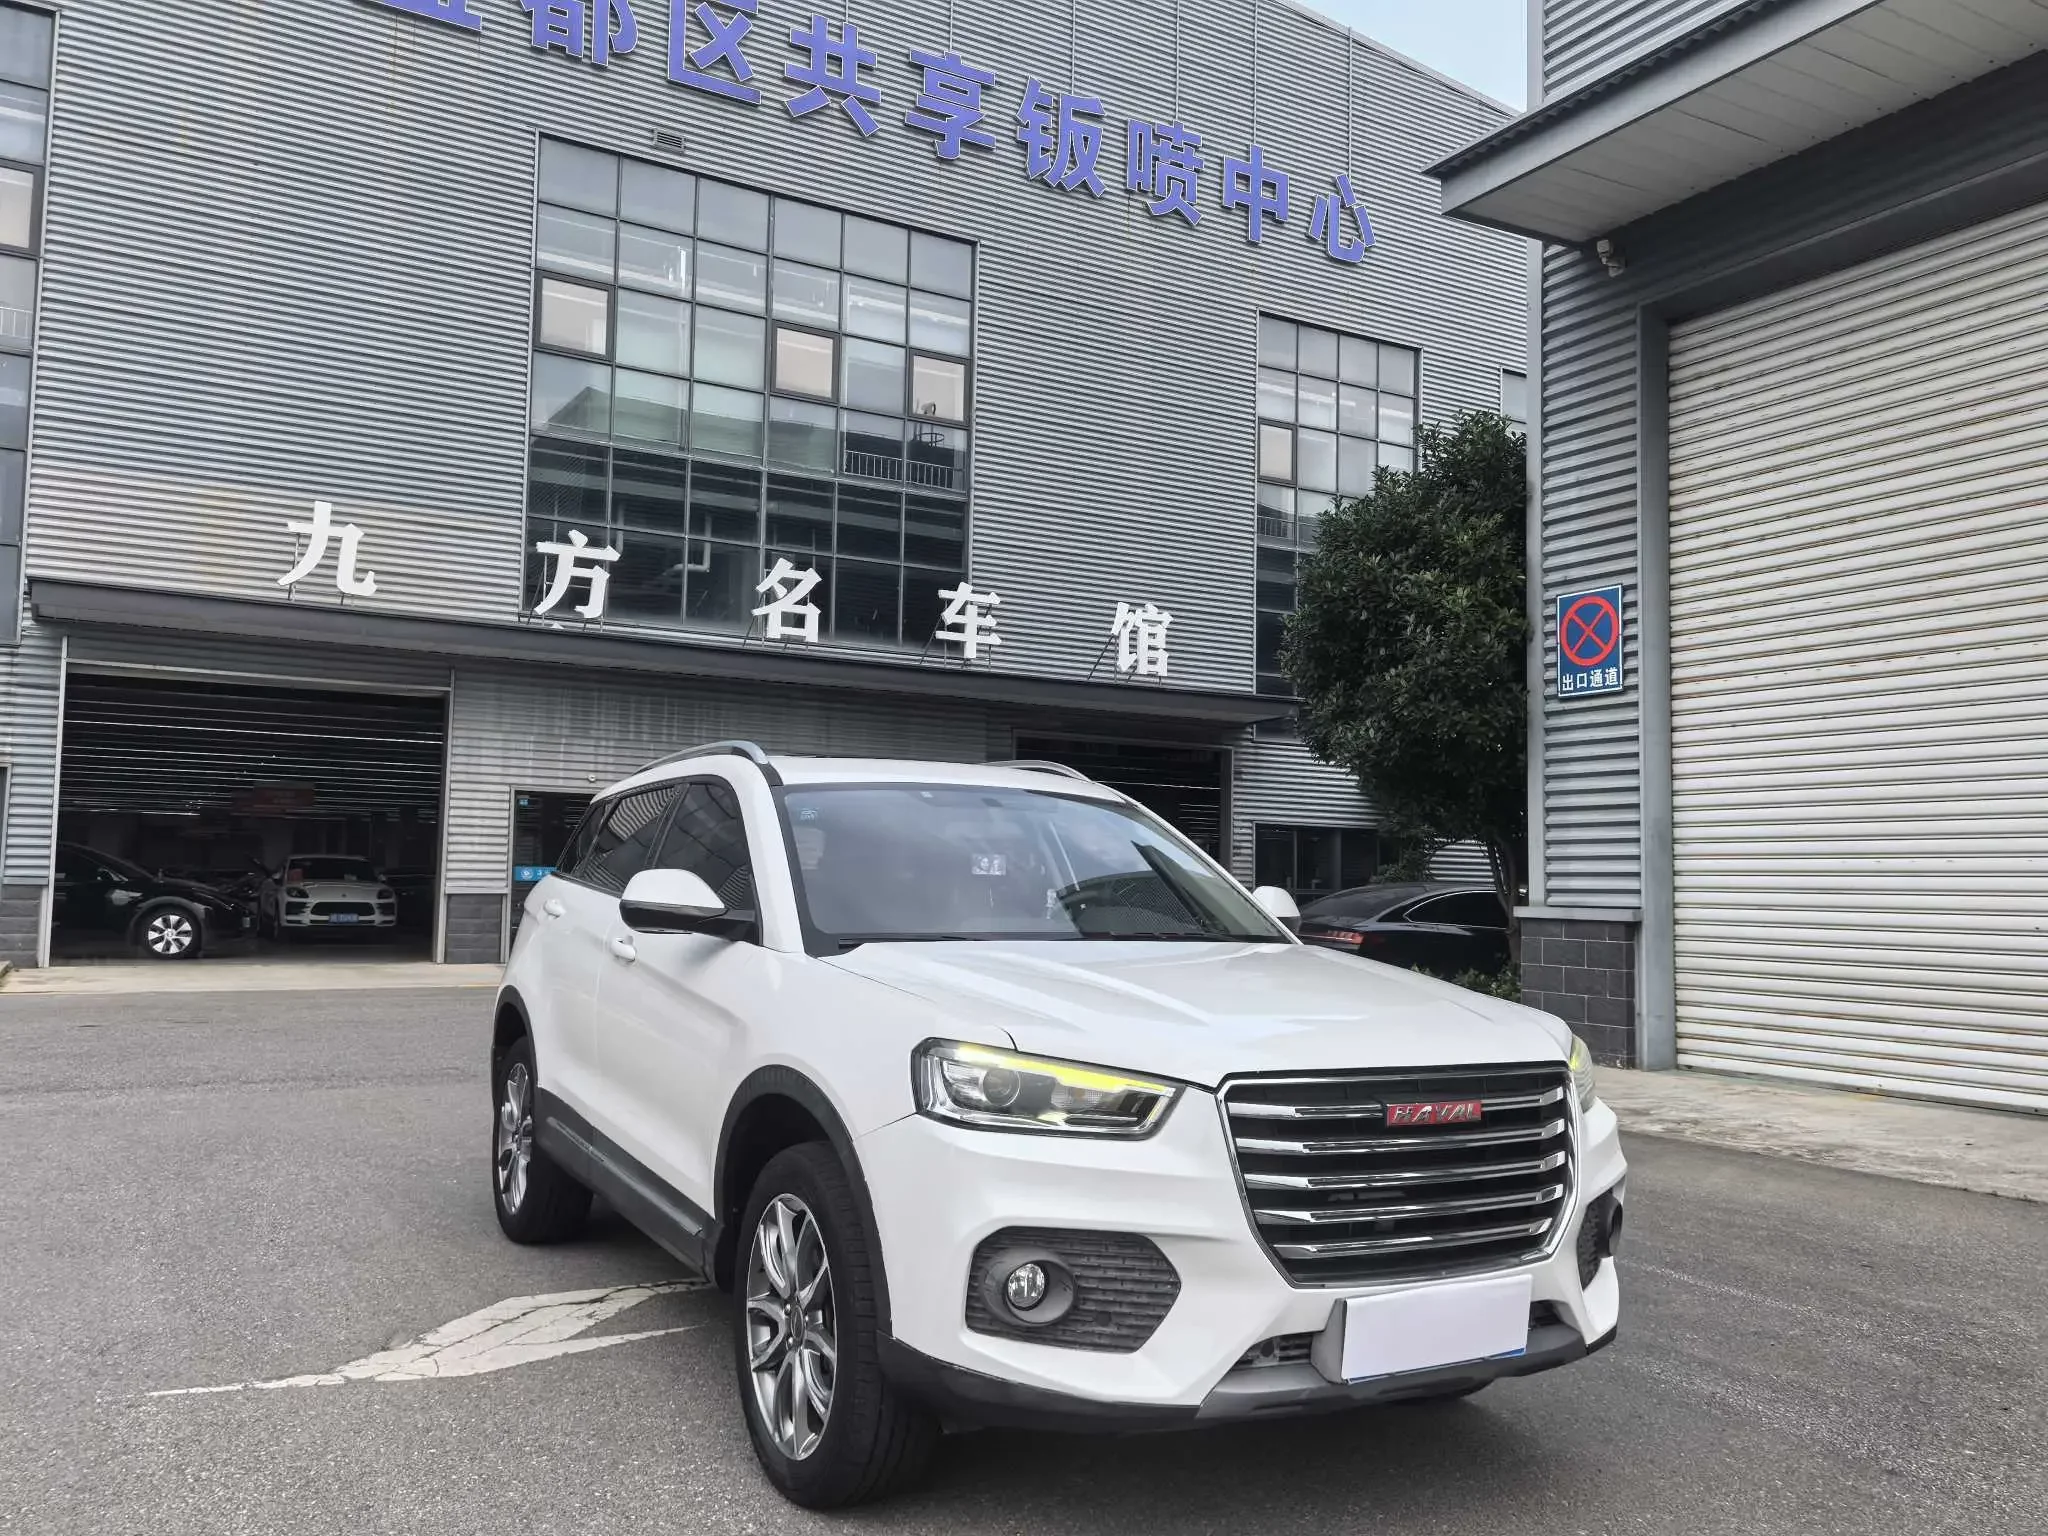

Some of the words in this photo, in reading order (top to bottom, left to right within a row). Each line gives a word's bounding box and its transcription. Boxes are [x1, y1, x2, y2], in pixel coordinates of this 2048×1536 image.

[362, 0, 1376, 263] 都区共享钣喷中心
[277, 500, 1174, 677] 九方名车馆
[1562, 667, 1618, 691] 出口通道
[1393, 1103, 1479, 1121] HAVAL
